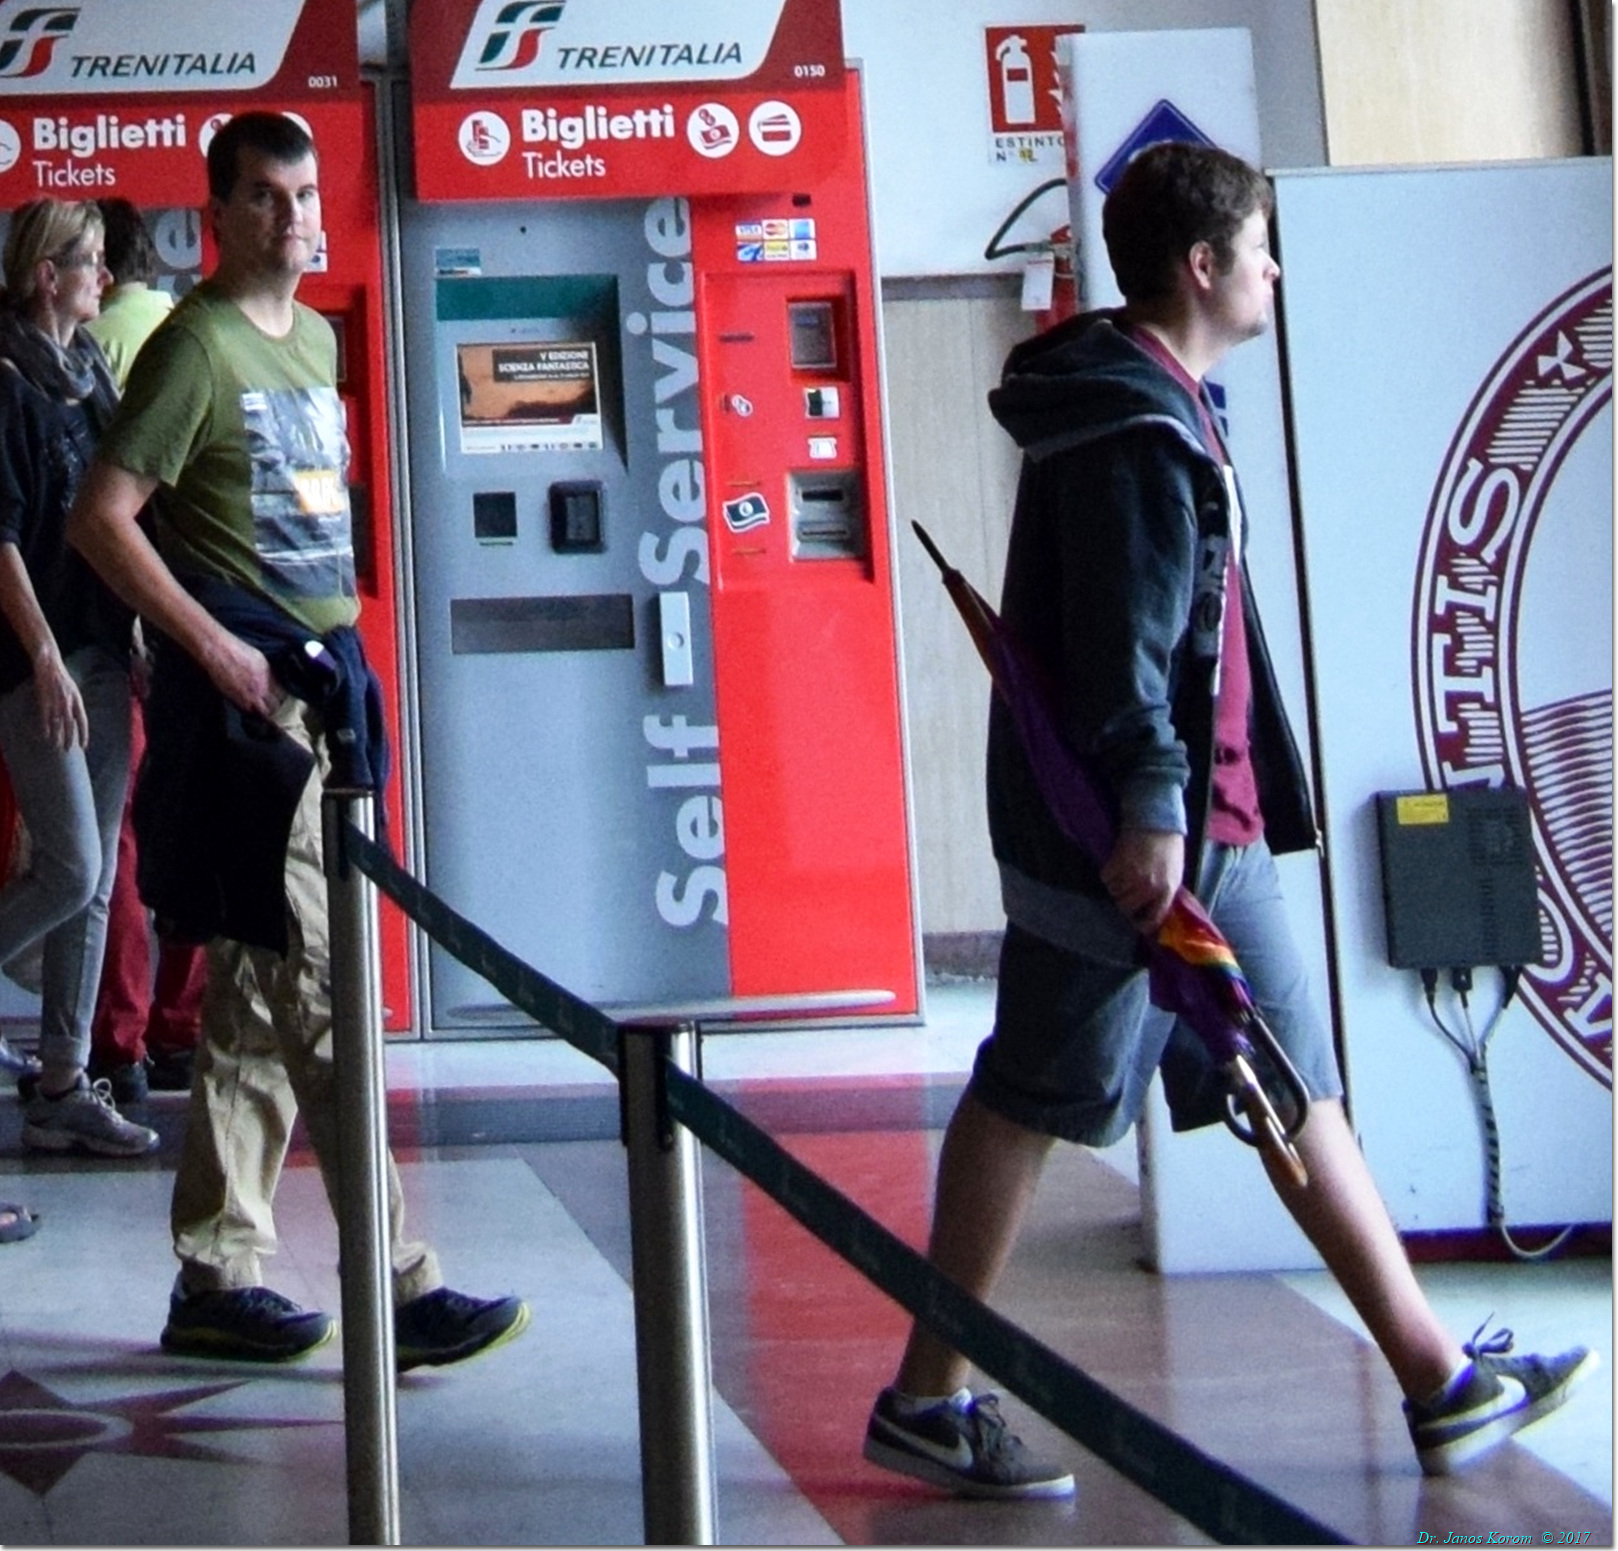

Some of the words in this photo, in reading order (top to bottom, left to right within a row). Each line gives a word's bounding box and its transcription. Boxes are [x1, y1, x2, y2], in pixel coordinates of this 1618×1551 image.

[71, 52, 256, 78] TRENITALIA
[557, 42, 742, 70] TRENITALIA
[308, 75, 338, 88] 0031
[793, 65, 826, 77] 0150
[32, 114, 186, 157] Biglietti
[521, 104, 675, 149] Biglietti
[32, 160, 116, 187] Tickets
[521, 151, 606, 179] Tickets
